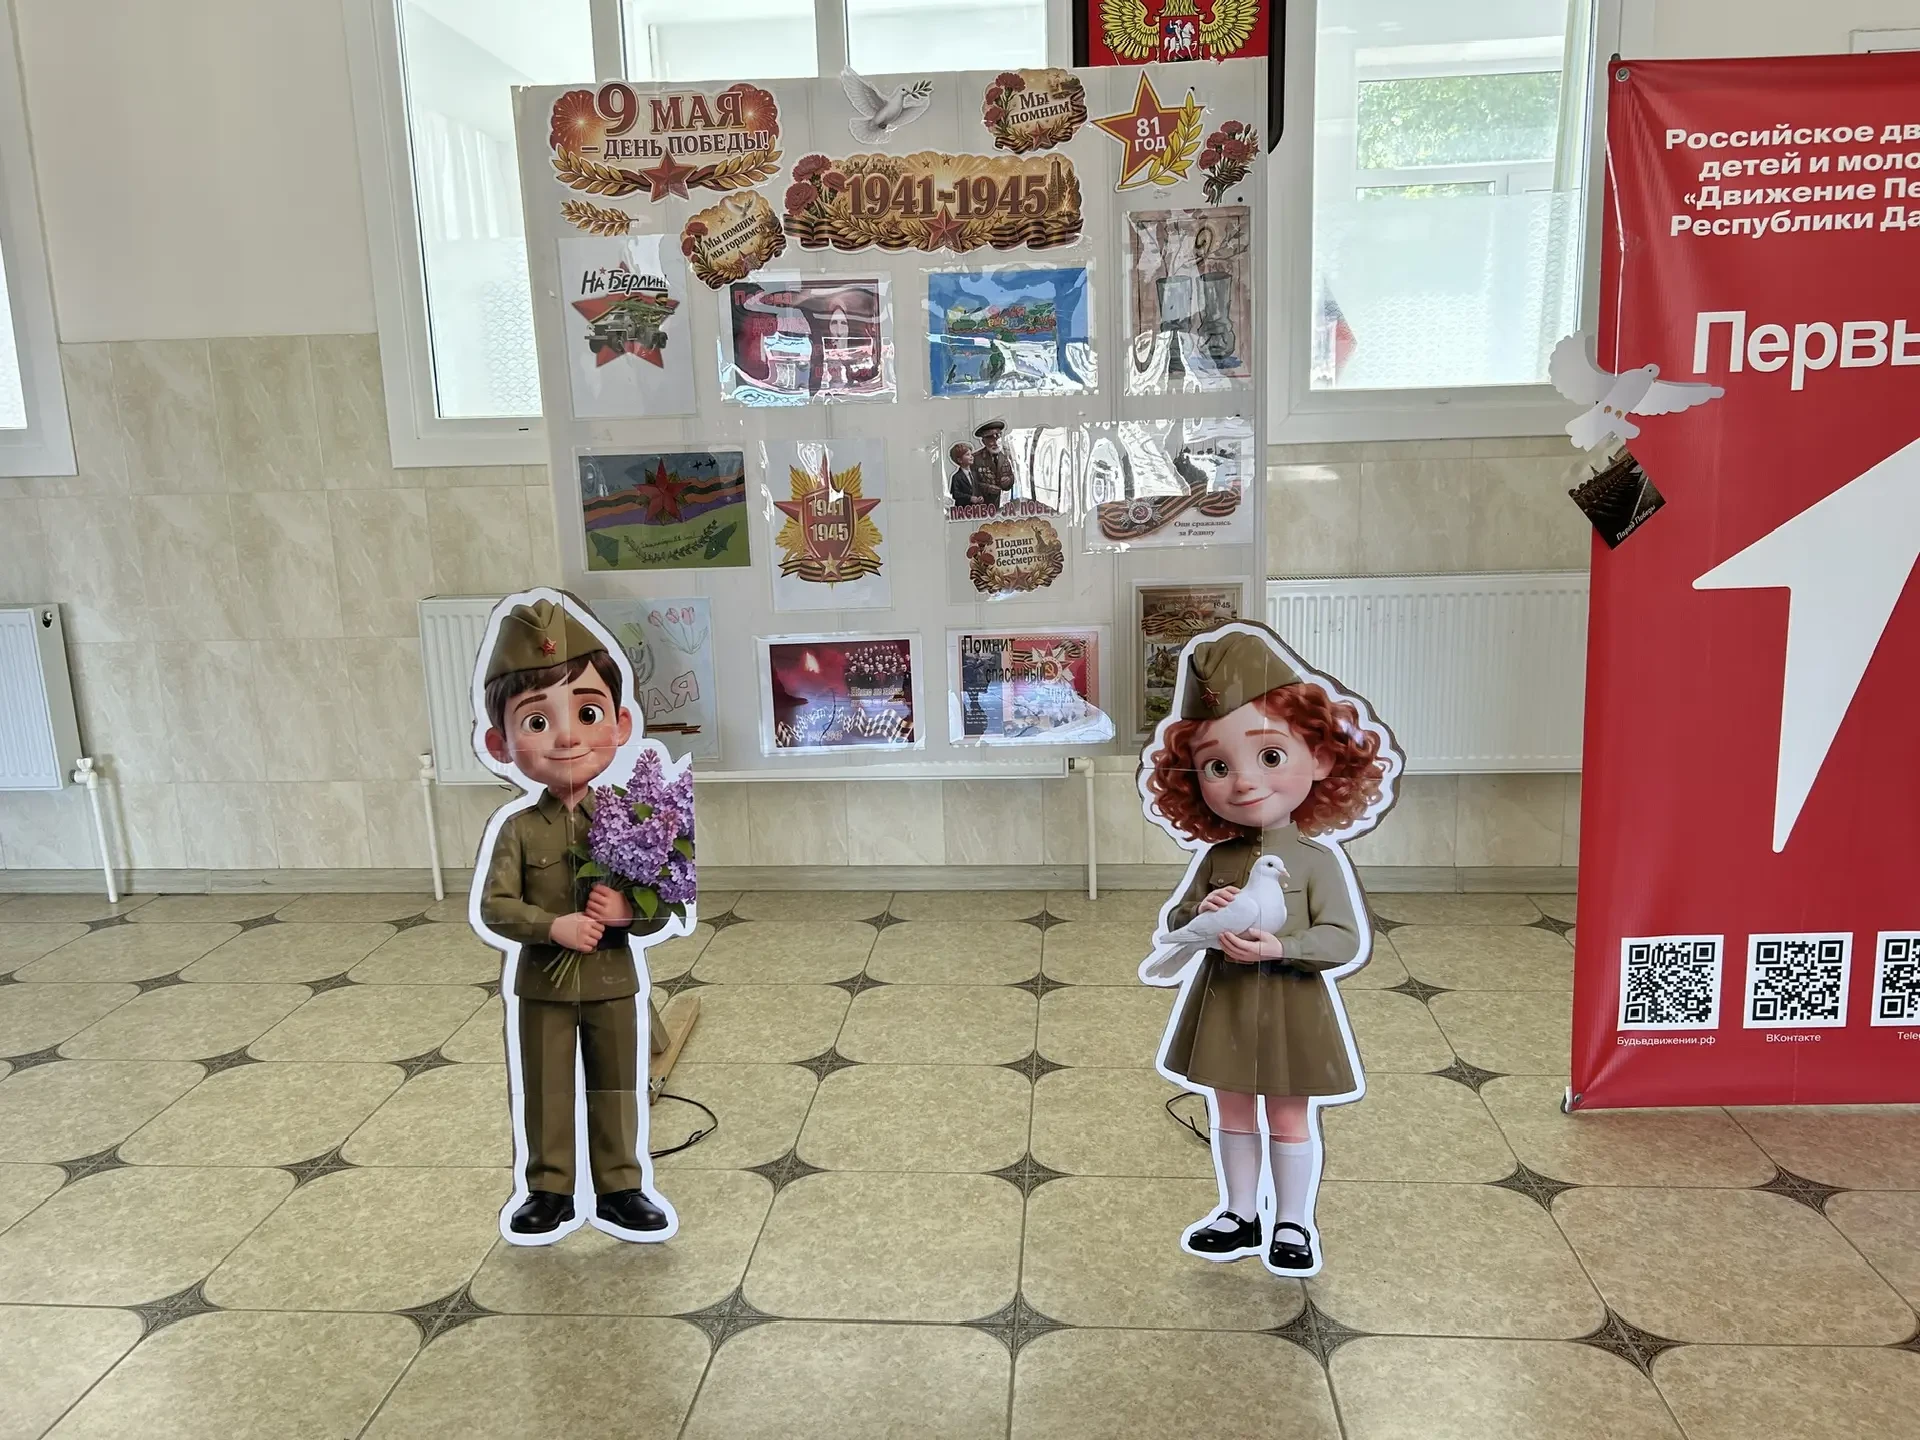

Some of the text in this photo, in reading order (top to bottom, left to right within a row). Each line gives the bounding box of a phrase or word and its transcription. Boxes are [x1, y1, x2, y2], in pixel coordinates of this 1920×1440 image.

[598, 83, 744, 134] 9 МАЯ
[1019, 91, 1049, 110] Мы
[1011, 101, 1071, 125] помним
[1136, 117, 1160, 137] 81
[1665, 124, 1874, 150] Российское
[604, 139, 662, 159] ДЕНЬ
[669, 131, 769, 154] ПОБЕДЫ!
[1135, 137, 1166, 152] ГОД
[1698, 152, 1802, 181] детей
[1809, 156, 1830, 173] и
[846, 174, 1049, 219] 1941-1945
[1683, 186, 1876, 210] «Движение
[703, 236, 722, 250] Мы
[721, 215, 757, 240] помним
[1670, 211, 1874, 238] Республики
[710, 223, 765, 260] мы гордимся
[809, 499, 844, 517] 1941
[949, 504, 997, 520] ПАСИБО
[1616, 504, 1656, 541] Парад Победы
[810, 524, 849, 542] 1945
[995, 538, 1034, 549] Подвиг
[997, 546, 1034, 558] народа
[996, 555, 1049, 567] бессмертен
[963, 635, 1016, 654] Помнит
[641, 670, 700, 720] АЯ
[1616, 1035, 1717, 1047] Будьвдвижении.рф
[1766, 1033, 1821, 1043] ВКонтакте
[1897, 1031, 1920, 1041] Tele
